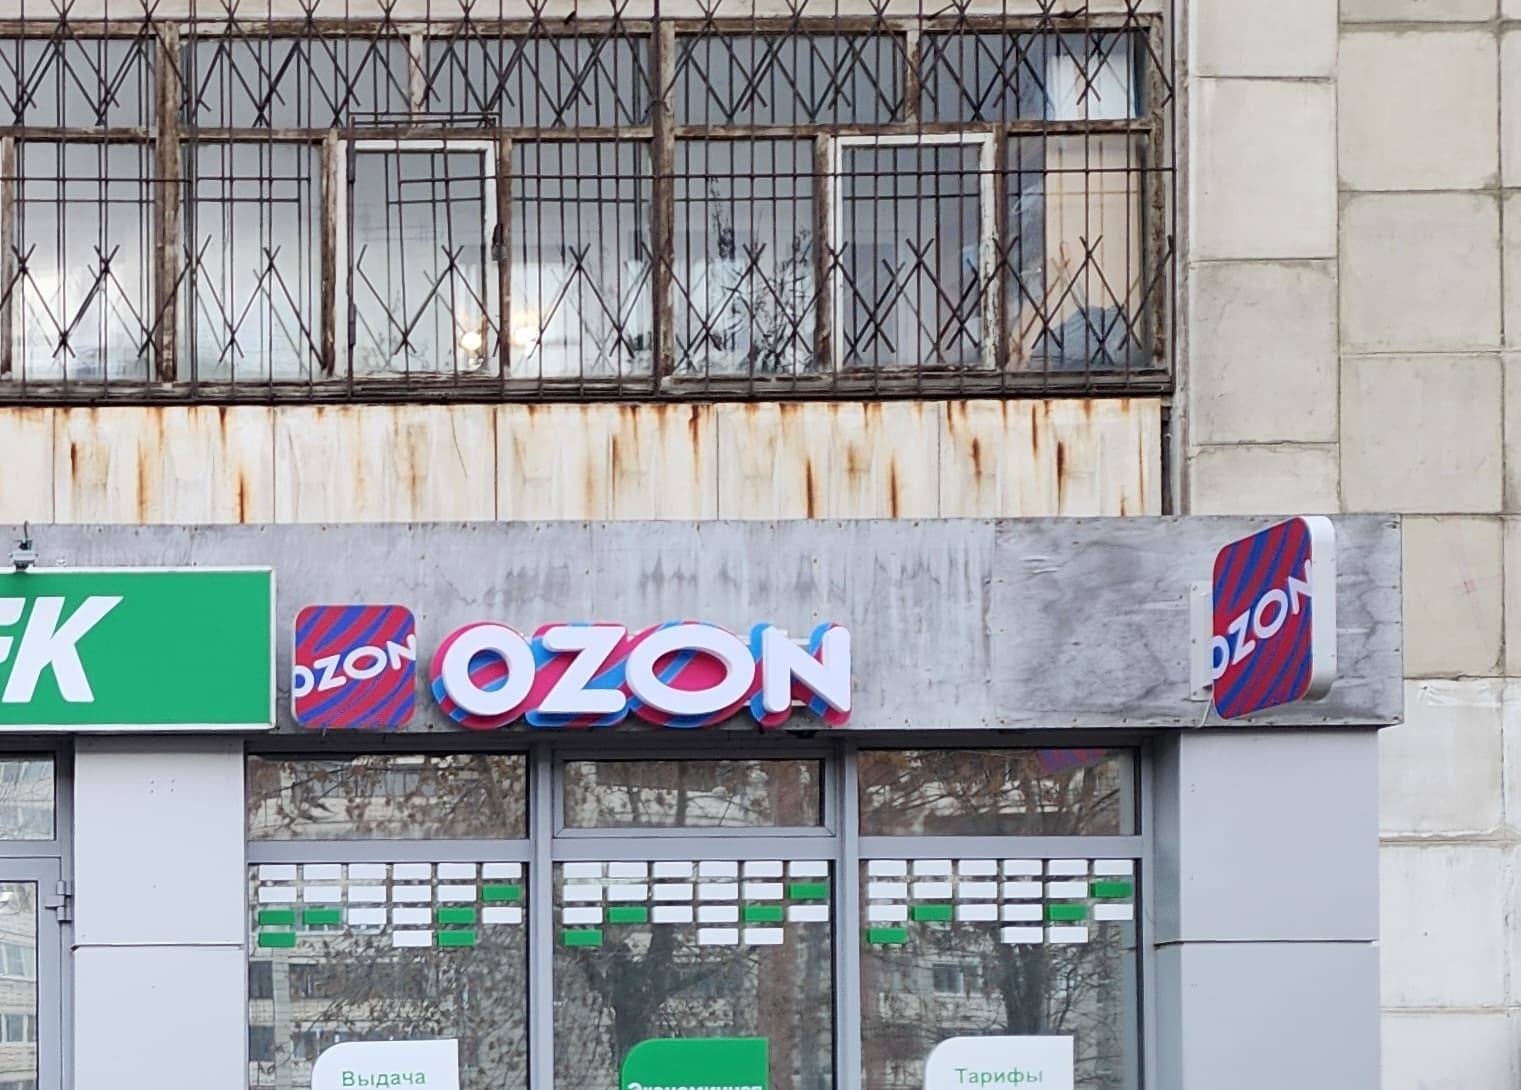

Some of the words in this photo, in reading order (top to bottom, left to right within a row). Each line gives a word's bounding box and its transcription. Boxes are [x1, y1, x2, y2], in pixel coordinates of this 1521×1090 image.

[1210, 559, 1312, 680] OZON
[293, 634, 416, 698] OZON
[437, 622, 852, 720] OZON
[342, 1070, 426, 1088] Выдача
[954, 1067, 1043, 1086] Тарифы
